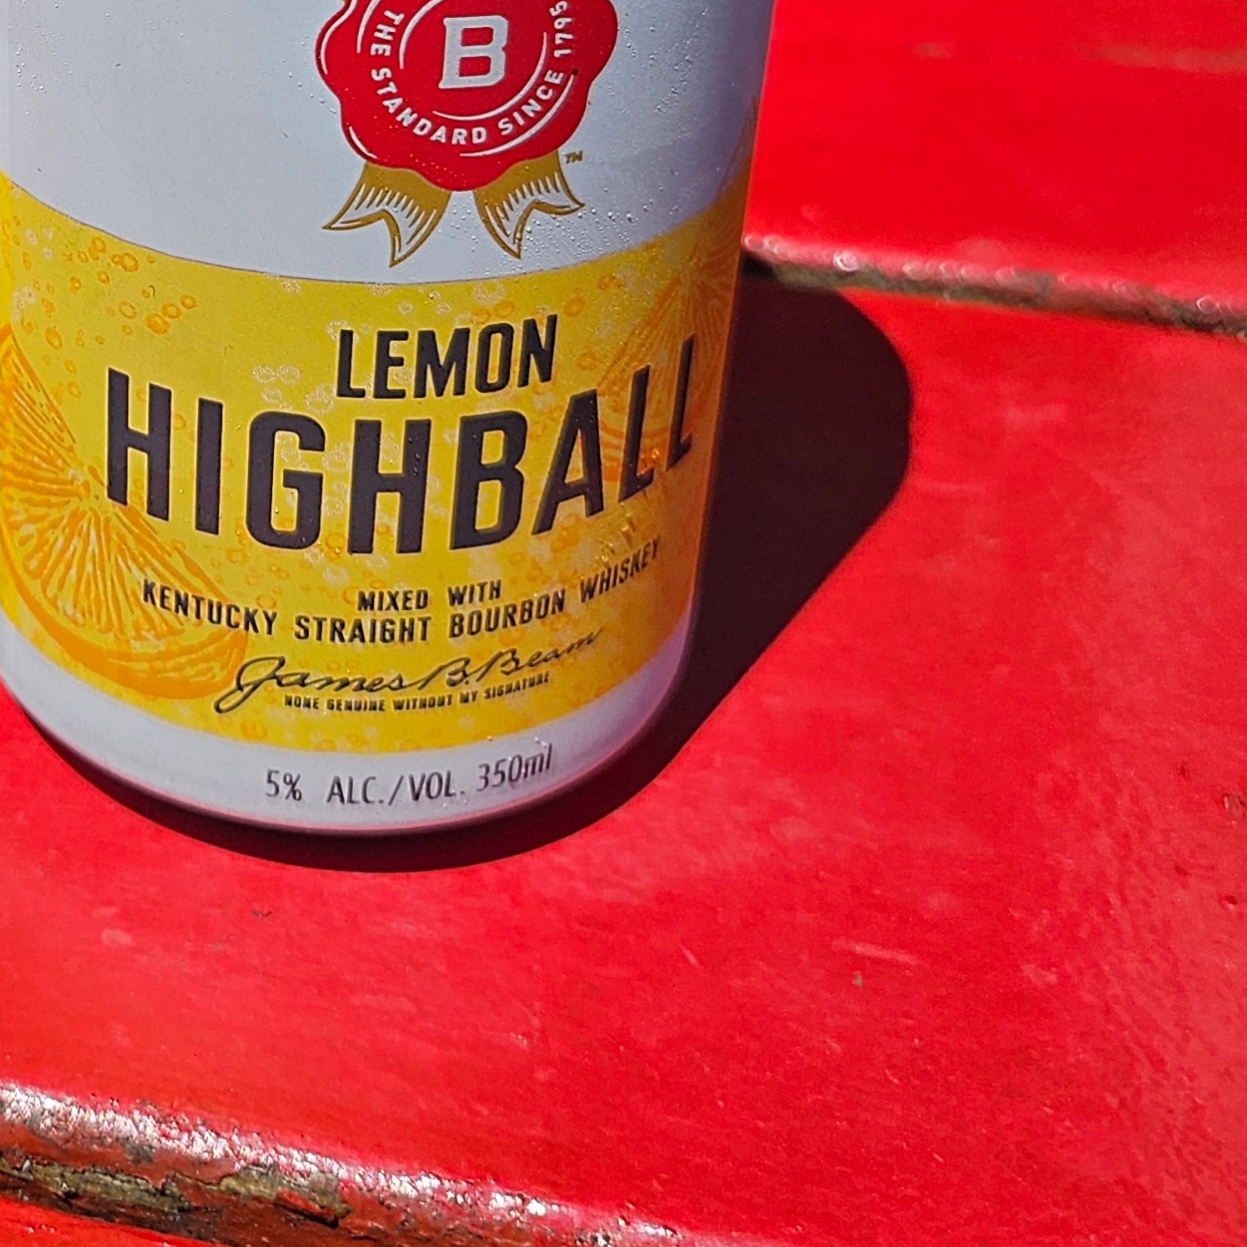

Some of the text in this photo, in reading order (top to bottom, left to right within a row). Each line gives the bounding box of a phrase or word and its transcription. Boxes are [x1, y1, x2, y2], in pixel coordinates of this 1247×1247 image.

[369, 0, 573, 146] THE STANDARD SINCE 1795
[438, 14, 509, 90] B
[336, 313, 559, 400] LEMON
[106, 334, 695, 556] HIGHBALL
[142, 539, 662, 645] KENTUCKY STRAIGHT BOURBON WHISKEY
[356, 579, 503, 613] MIXED WITH
[213, 654, 418, 716] James
[476, 627, 604, 684] Beam
[284, 671, 551, 713] NONE GENUINE WITHOUT MY SIGNATURE
[264, 745, 554, 808] 5% ALC./VOL. 350ml
